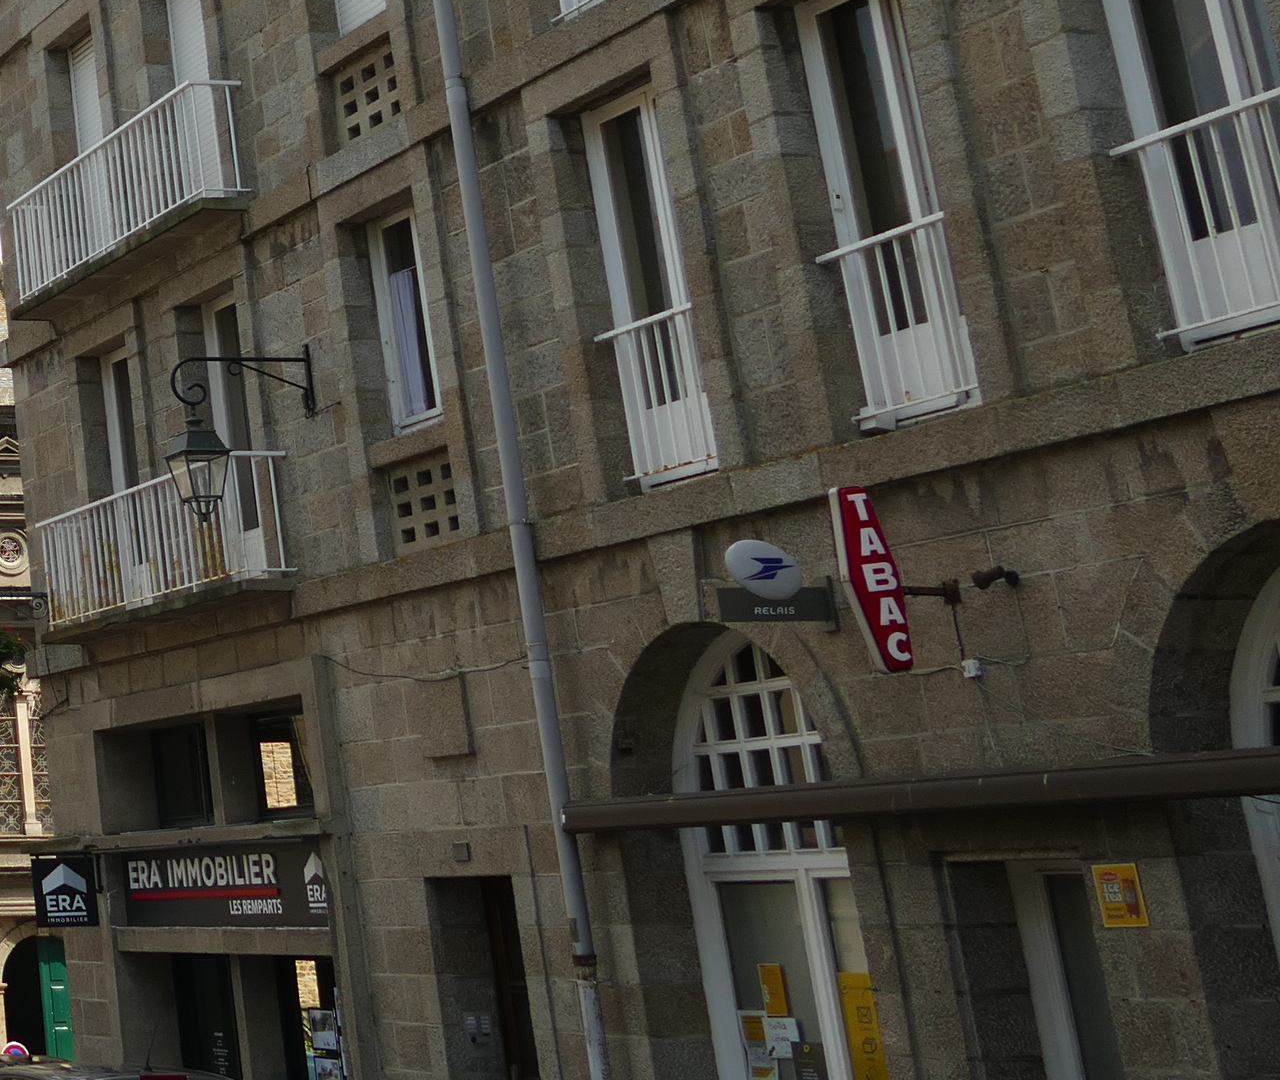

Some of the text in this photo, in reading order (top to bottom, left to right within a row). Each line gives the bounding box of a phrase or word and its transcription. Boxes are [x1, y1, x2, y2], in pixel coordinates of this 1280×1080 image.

[847, 493, 911, 661] TABAC
[754, 606, 795, 615] RELAIS
[128, 853, 276, 889] ERA IMMOBILIER
[45, 894, 87, 911] ERA
[229, 899, 283, 915] LES REMPARTS
